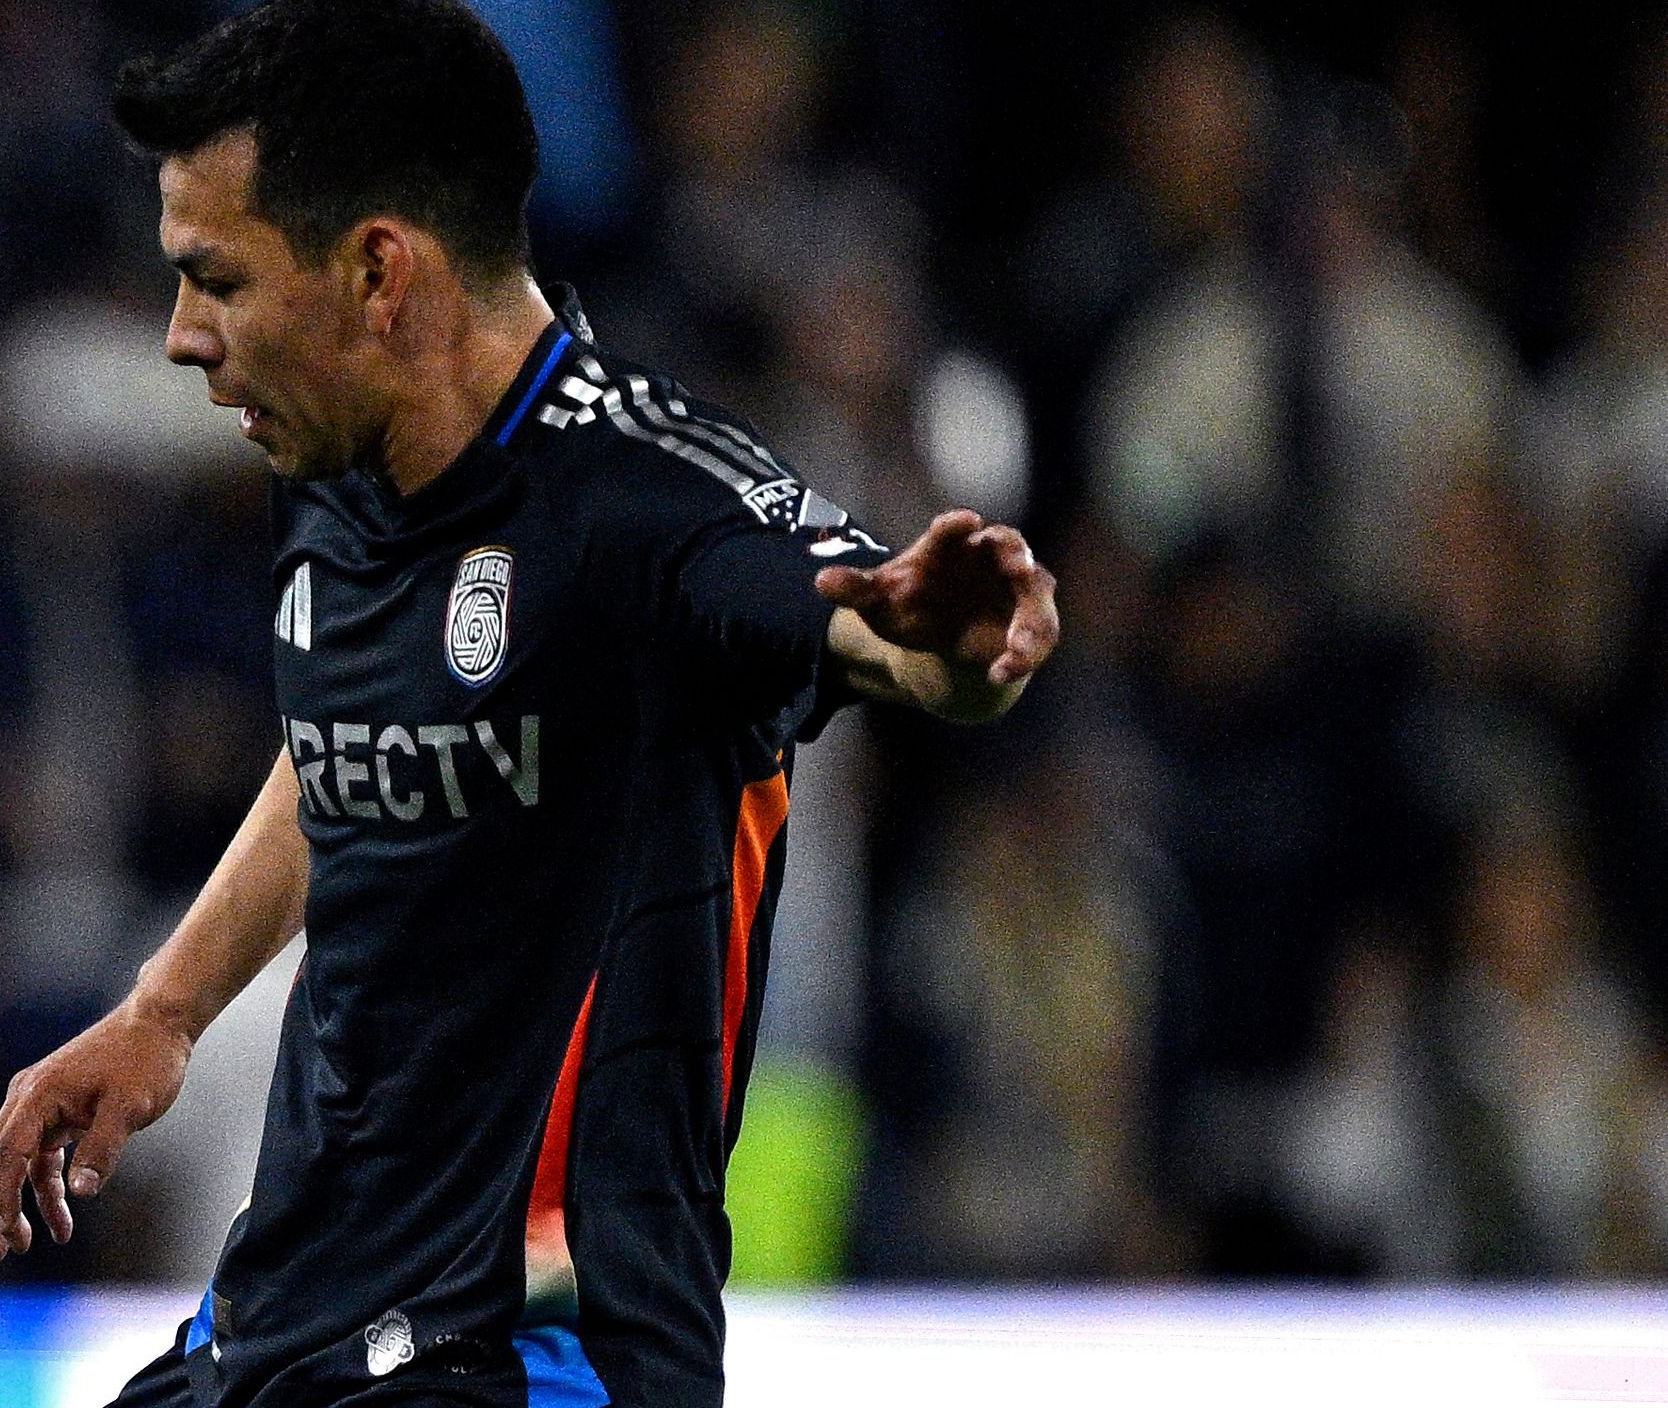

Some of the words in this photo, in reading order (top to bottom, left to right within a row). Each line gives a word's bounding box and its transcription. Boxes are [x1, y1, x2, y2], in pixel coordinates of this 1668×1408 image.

[459, 559, 481, 587] SAN
[480, 557, 510, 586] DIEGO
[282, 714, 540, 821] RECTV
